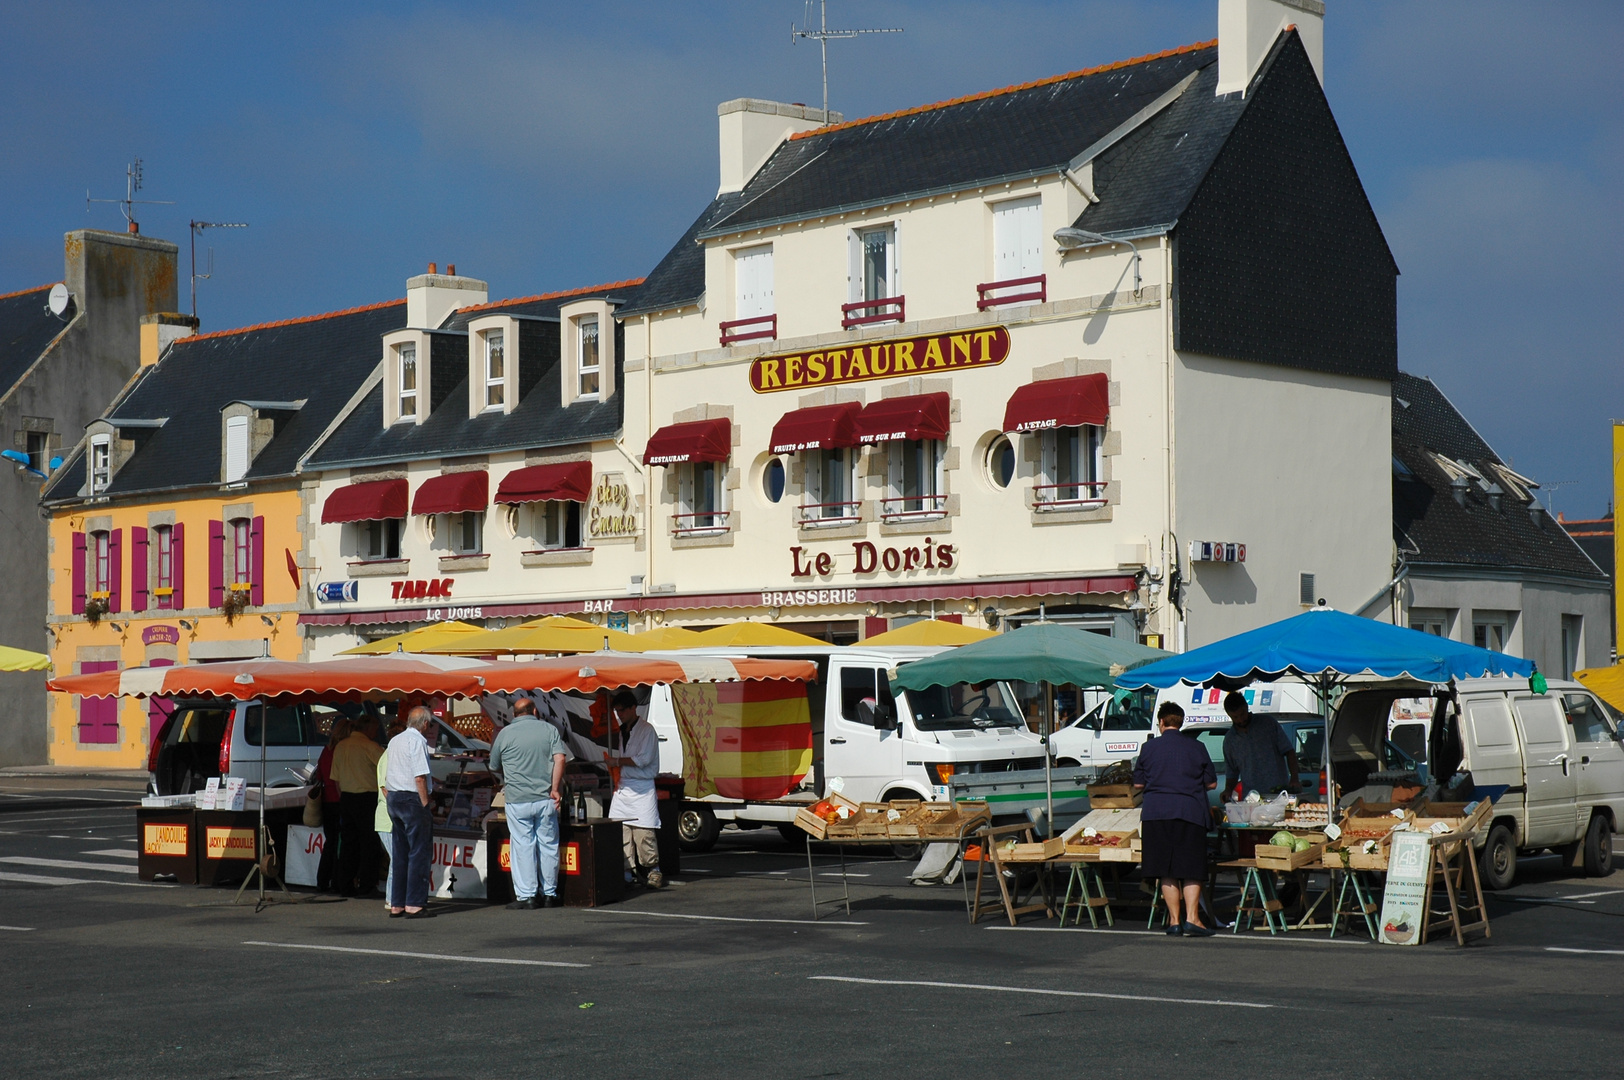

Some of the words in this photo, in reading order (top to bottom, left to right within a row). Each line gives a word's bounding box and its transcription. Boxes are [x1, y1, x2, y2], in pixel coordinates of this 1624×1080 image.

[760, 330, 997, 389] RESTAURANT
[1026, 419, 1057, 430] L'ETAGE
[860, 435, 874, 443] VUE
[875, 433, 890, 441] SUR
[890, 431, 906, 440] MER
[774, 444, 796, 452] FRUITS
[806, 441, 820, 449] MER
[650, 454, 690, 463] RESTAURANT
[589, 505, 637, 537] Emma
[790, 546, 832, 577] Le
[852, 537, 954, 573] Doris
[1202, 543, 1246, 562] LOTO
[391, 578, 454, 600] TABAC
[762, 588, 857, 606] BRASSERIE
[583, 599, 614, 612] BAR
[425, 608, 441, 621] Le
[156, 826, 186, 844] L'ANDOUILLE
[145, 842, 162, 854] JACKY
[209, 836, 222, 847] JACKY
[222, 836, 254, 849] L'ANDOUILLE
[1399, 850, 1418, 865] AB
